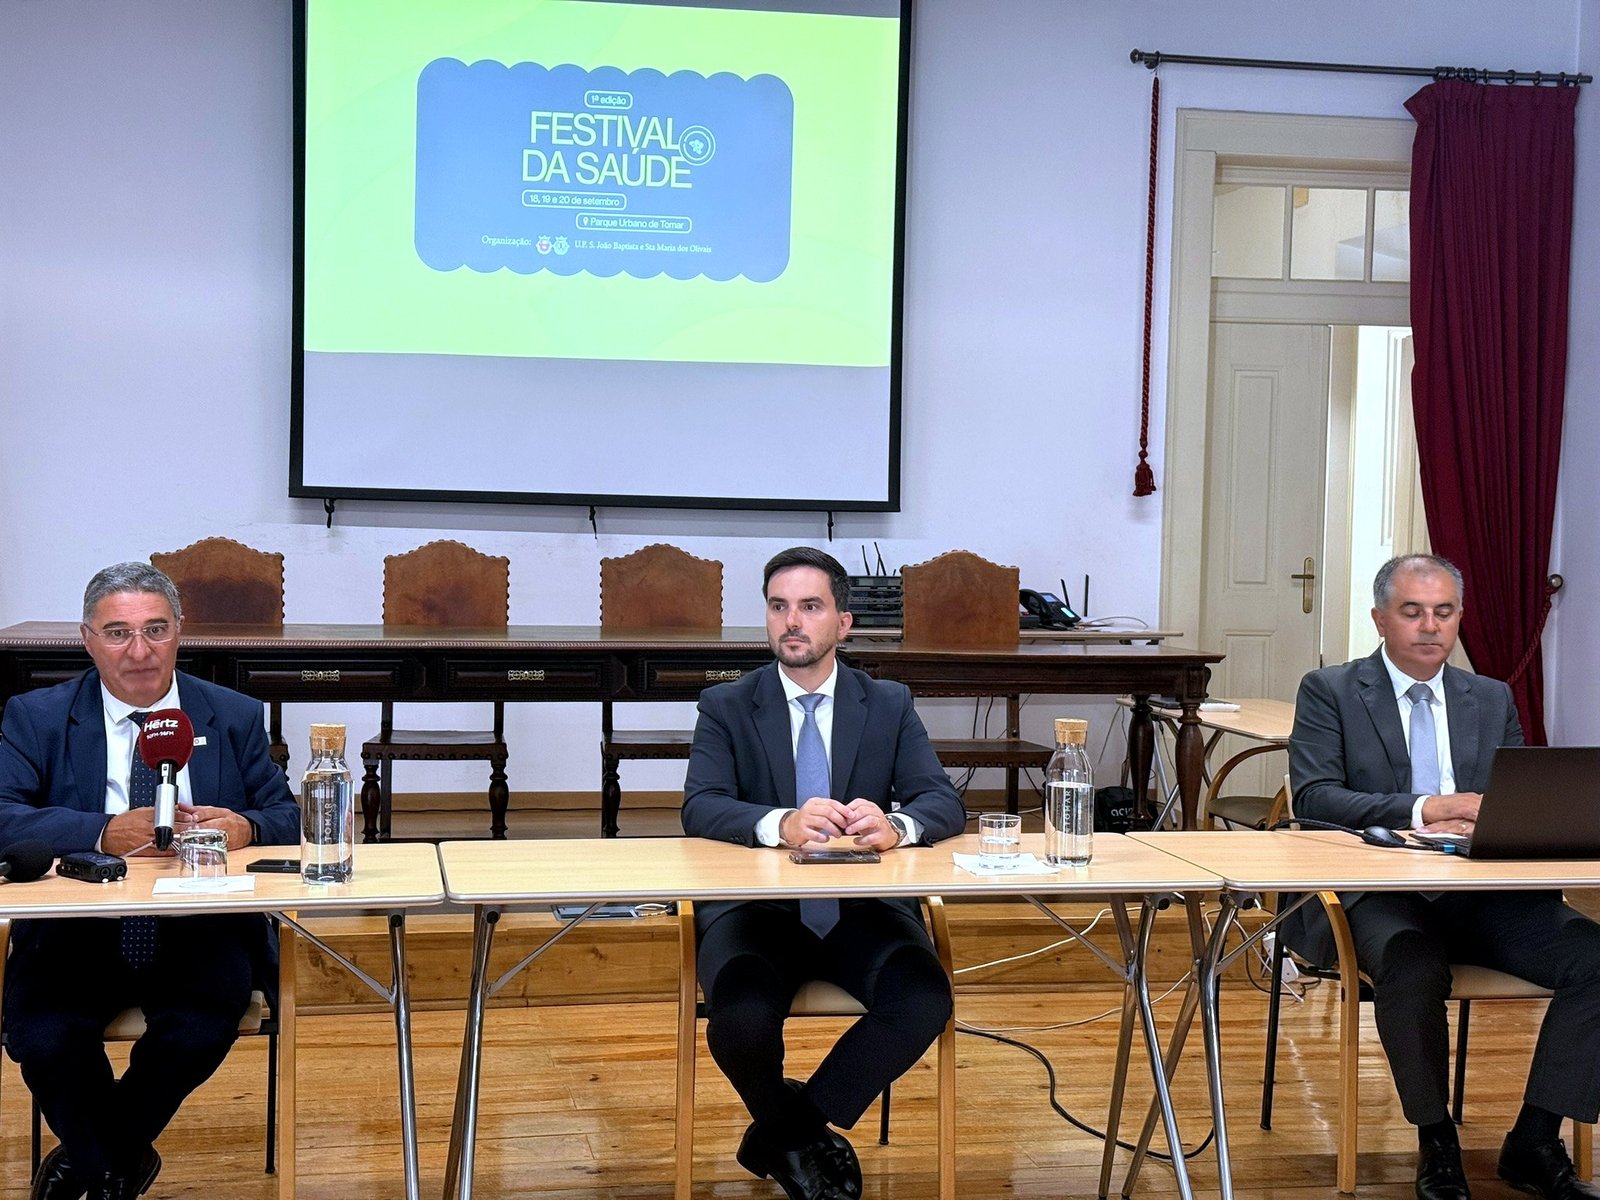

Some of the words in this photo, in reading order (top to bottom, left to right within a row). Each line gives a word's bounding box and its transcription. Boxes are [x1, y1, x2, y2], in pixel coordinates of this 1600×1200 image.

[600, 95, 627, 106] edição
[530, 110, 680, 150] FESTIVAL
[522, 149, 571, 184] DA
[575, 148, 693, 189] SAÚDE
[529, 194, 540, 203] 18,
[541, 194, 551, 203] 19
[558, 195, 570, 204] 20
[571, 196, 582, 205] de
[582, 196, 620, 207] setembro
[590, 217, 617, 228] Parque
[618, 218, 647, 228] Urbano
[648, 219, 658, 229] de
[660, 219, 684, 230] Tomar
[481, 235, 532, 247] Organização:
[596, 240, 612, 249] João
[613, 241, 639, 252] Baptista
[656, 243, 676, 252] Maria
[689, 244, 712, 253] Olivais
[324, 802, 333, 842] TOMAR
